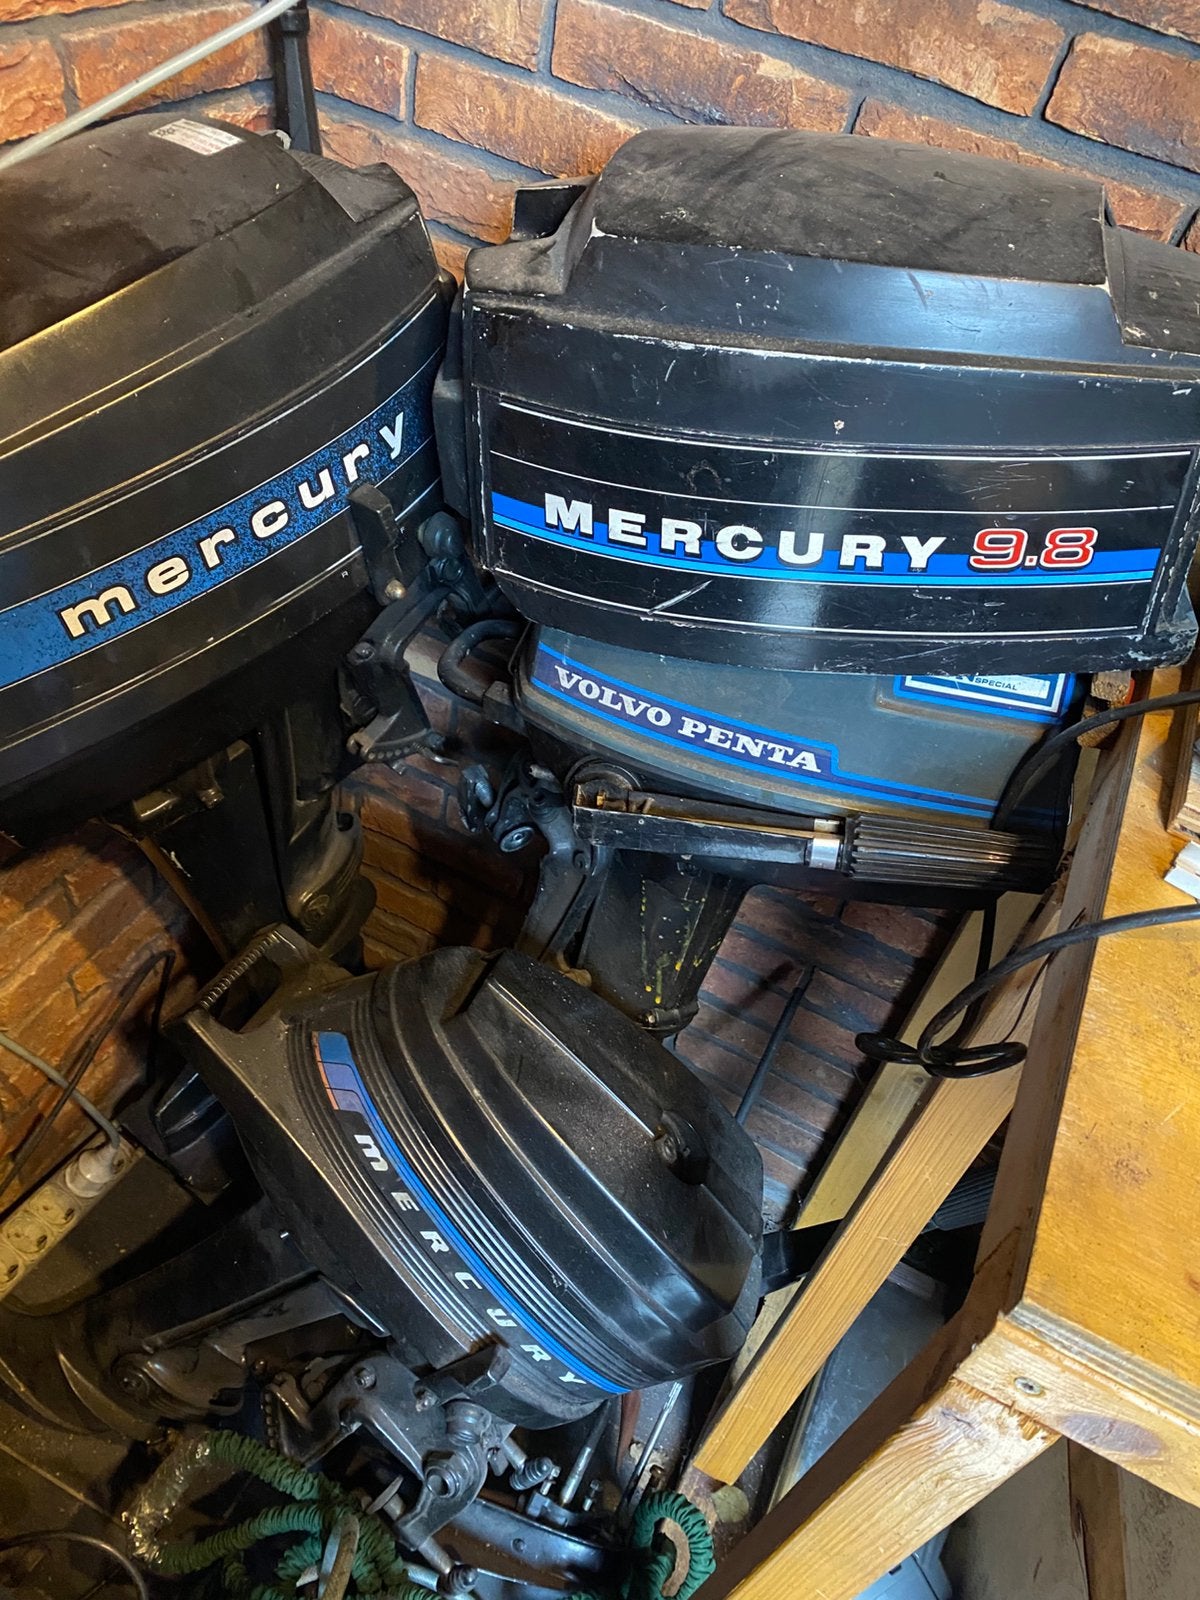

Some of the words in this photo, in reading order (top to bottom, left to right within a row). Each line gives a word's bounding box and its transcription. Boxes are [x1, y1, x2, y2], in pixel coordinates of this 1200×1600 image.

[59, 411, 404, 638] mercury
[544, 492, 947, 570] MERCURY
[968, 526, 1099, 570] 9.8
[555, 665, 672, 727] VOLVO
[677, 716, 822, 774] PENTA
[974, 677, 1018, 691] SPECIAL
